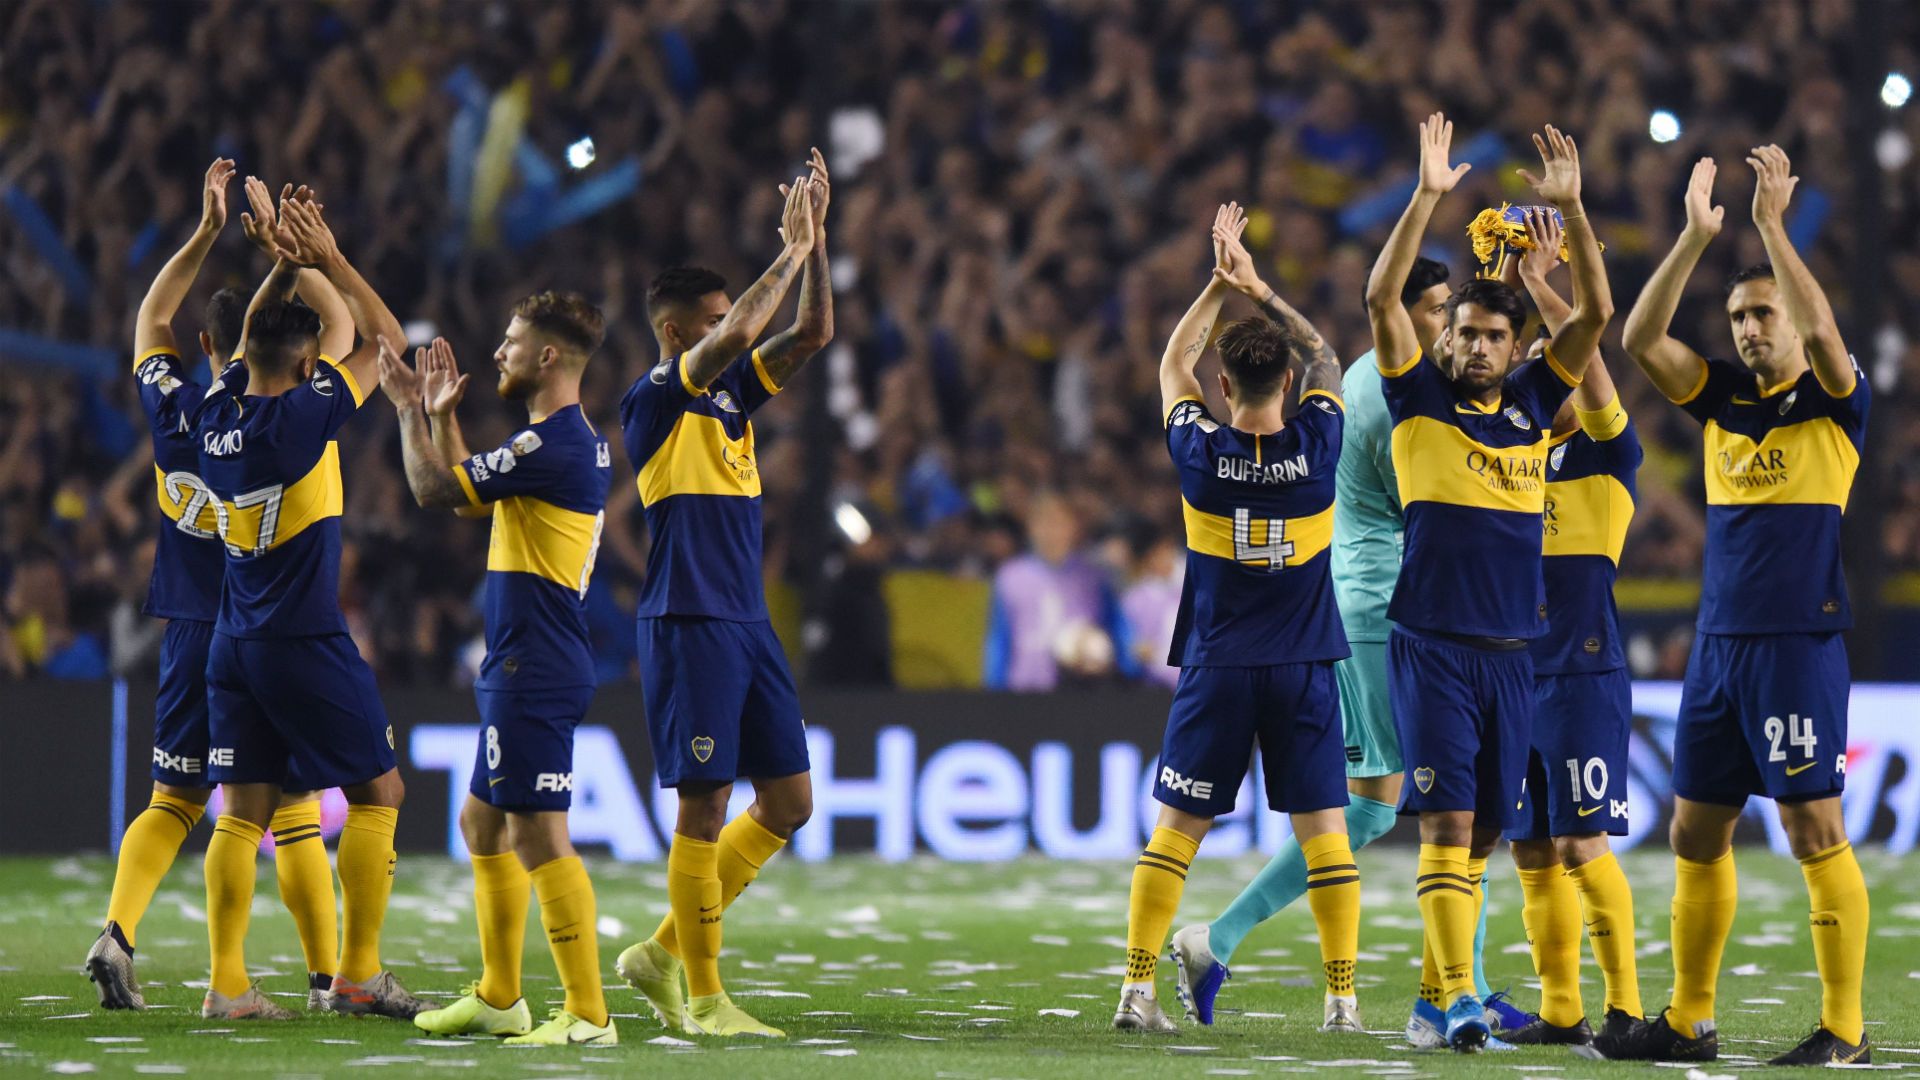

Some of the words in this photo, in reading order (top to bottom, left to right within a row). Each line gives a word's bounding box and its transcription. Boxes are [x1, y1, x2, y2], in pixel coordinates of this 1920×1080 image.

[1217, 455, 1309, 484] BUFFARINI
[1466, 451, 1543, 478] QATAR
[1487, 477, 1538, 492] AIRWAYS
[1234, 508, 1294, 570] 4
[486, 725, 502, 770] 8
[1764, 714, 1818, 762] 24
[153, 747, 201, 774] AXE
[209, 748, 234, 767] XE
[536, 773, 573, 792] AX
[1160, 766, 1214, 800] AXE
[1566, 757, 1609, 802] 10
